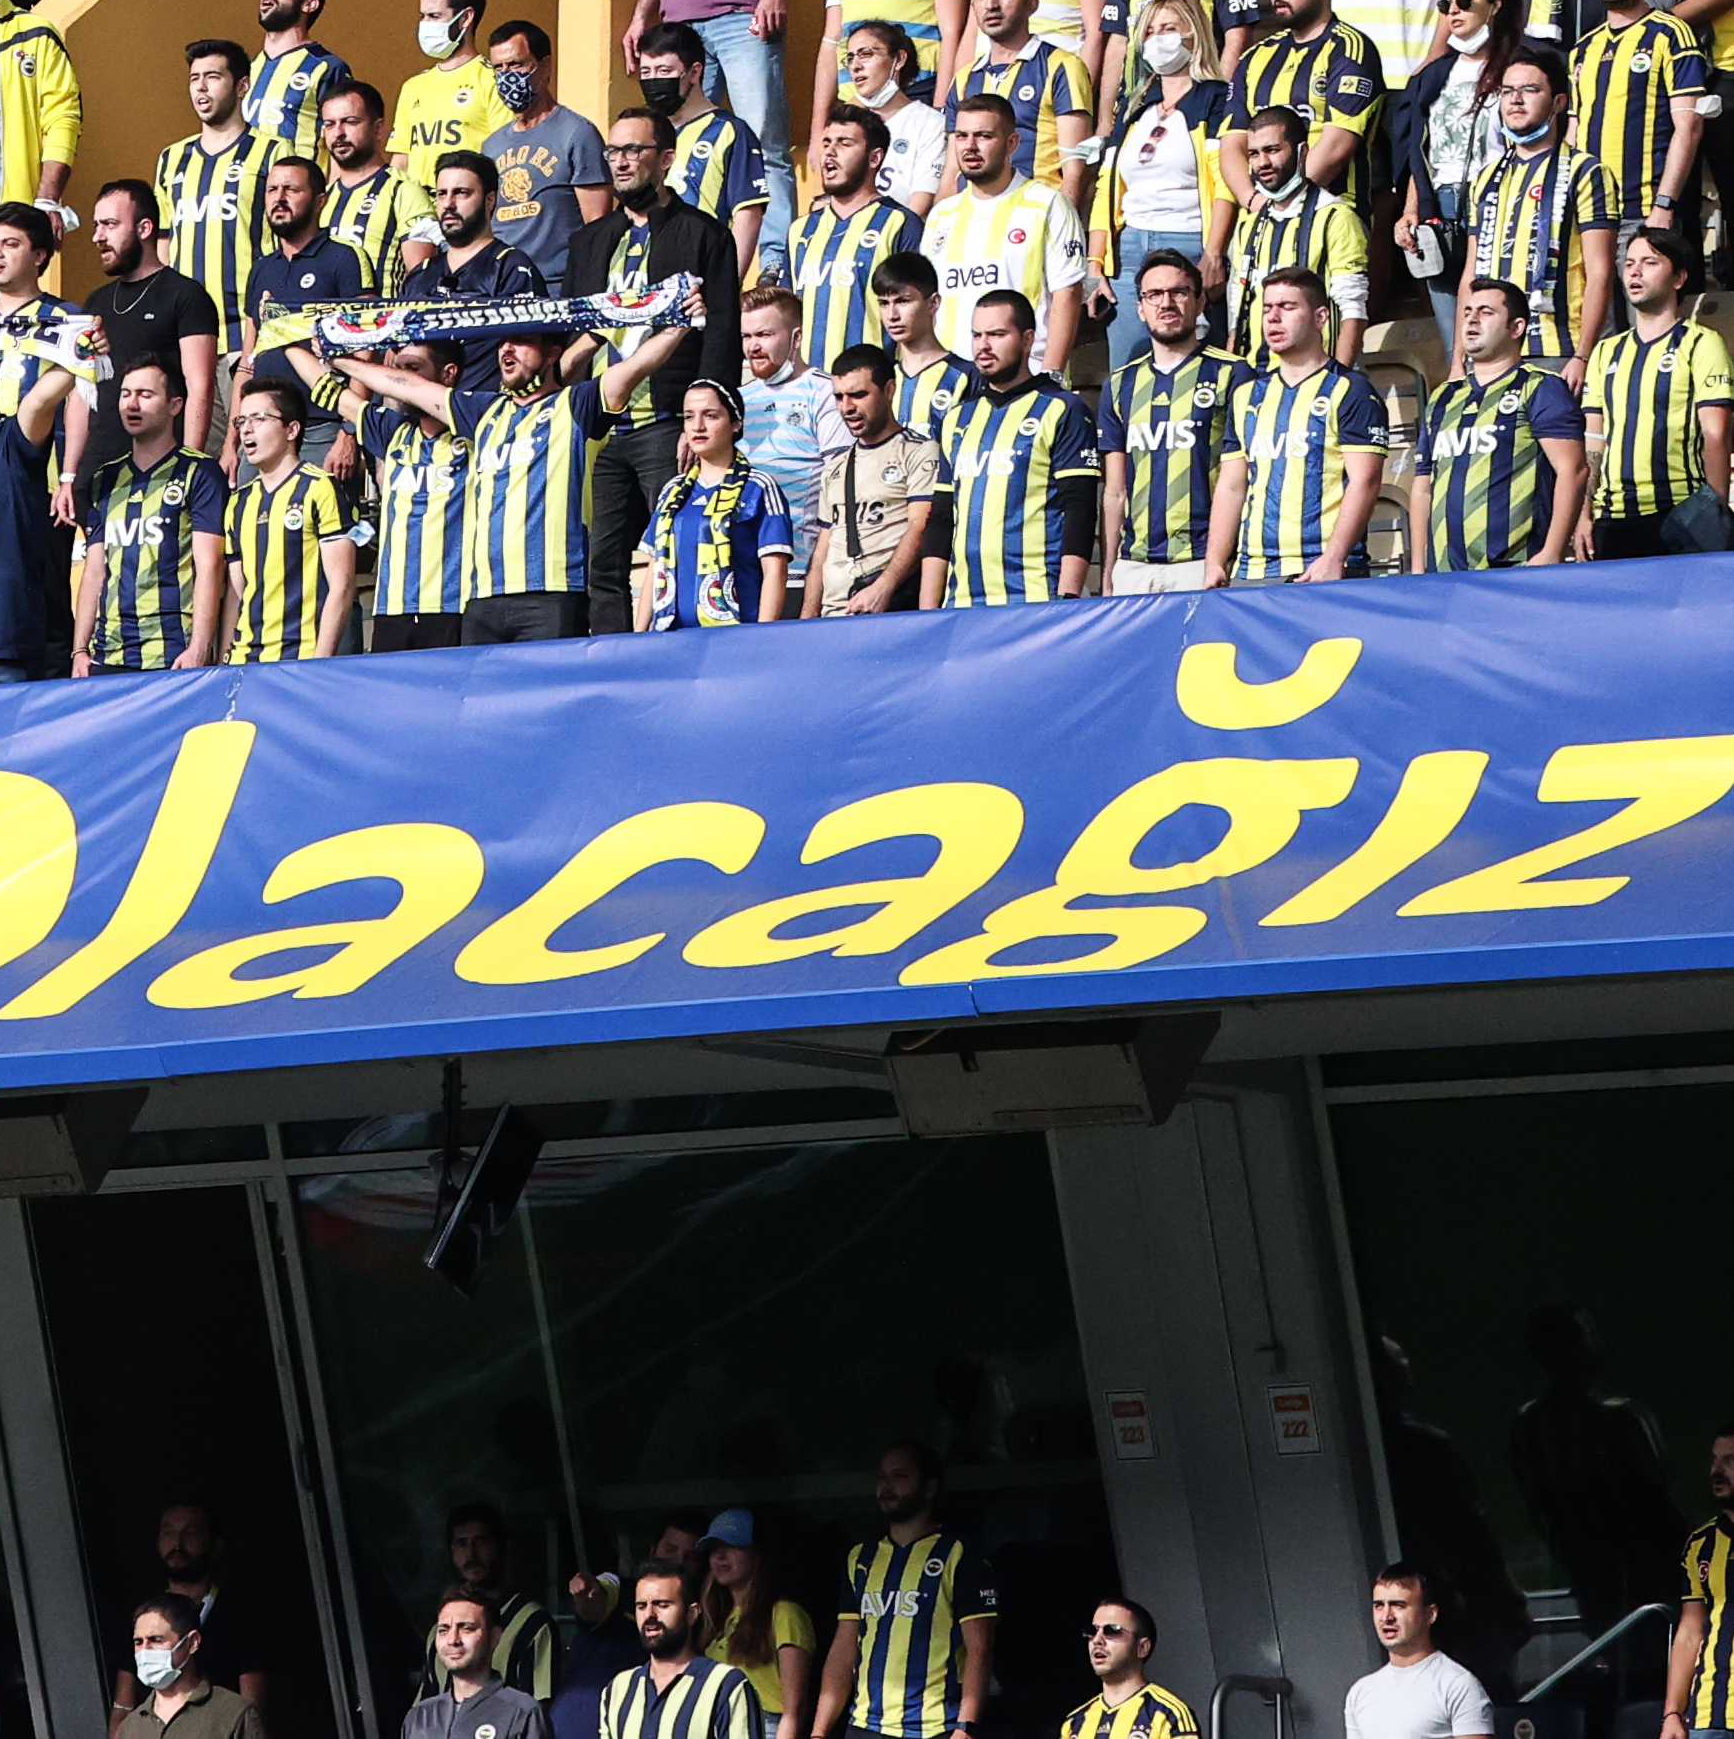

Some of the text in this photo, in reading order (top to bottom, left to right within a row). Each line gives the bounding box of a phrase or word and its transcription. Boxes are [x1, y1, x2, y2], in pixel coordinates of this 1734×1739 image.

[410, 121, 462, 147] AVIS
[173, 193, 238, 223] AVIS
[797, 260, 853, 287] AVIS
[946, 264, 999, 290] avea
[1126, 420, 1194, 453] AVIS
[1249, 431, 1308, 461] AVIS
[1432, 425, 1495, 457] AVIS
[478, 438, 534, 469] AVIS
[952, 451, 1014, 479] AVIS
[393, 466, 454, 493] AVIS
[104, 517, 164, 548] AVIS
[1120, 1425, 1145, 1444] 223
[1282, 1422, 1309, 1439] 222
[860, 1591, 921, 1618] AVIS
